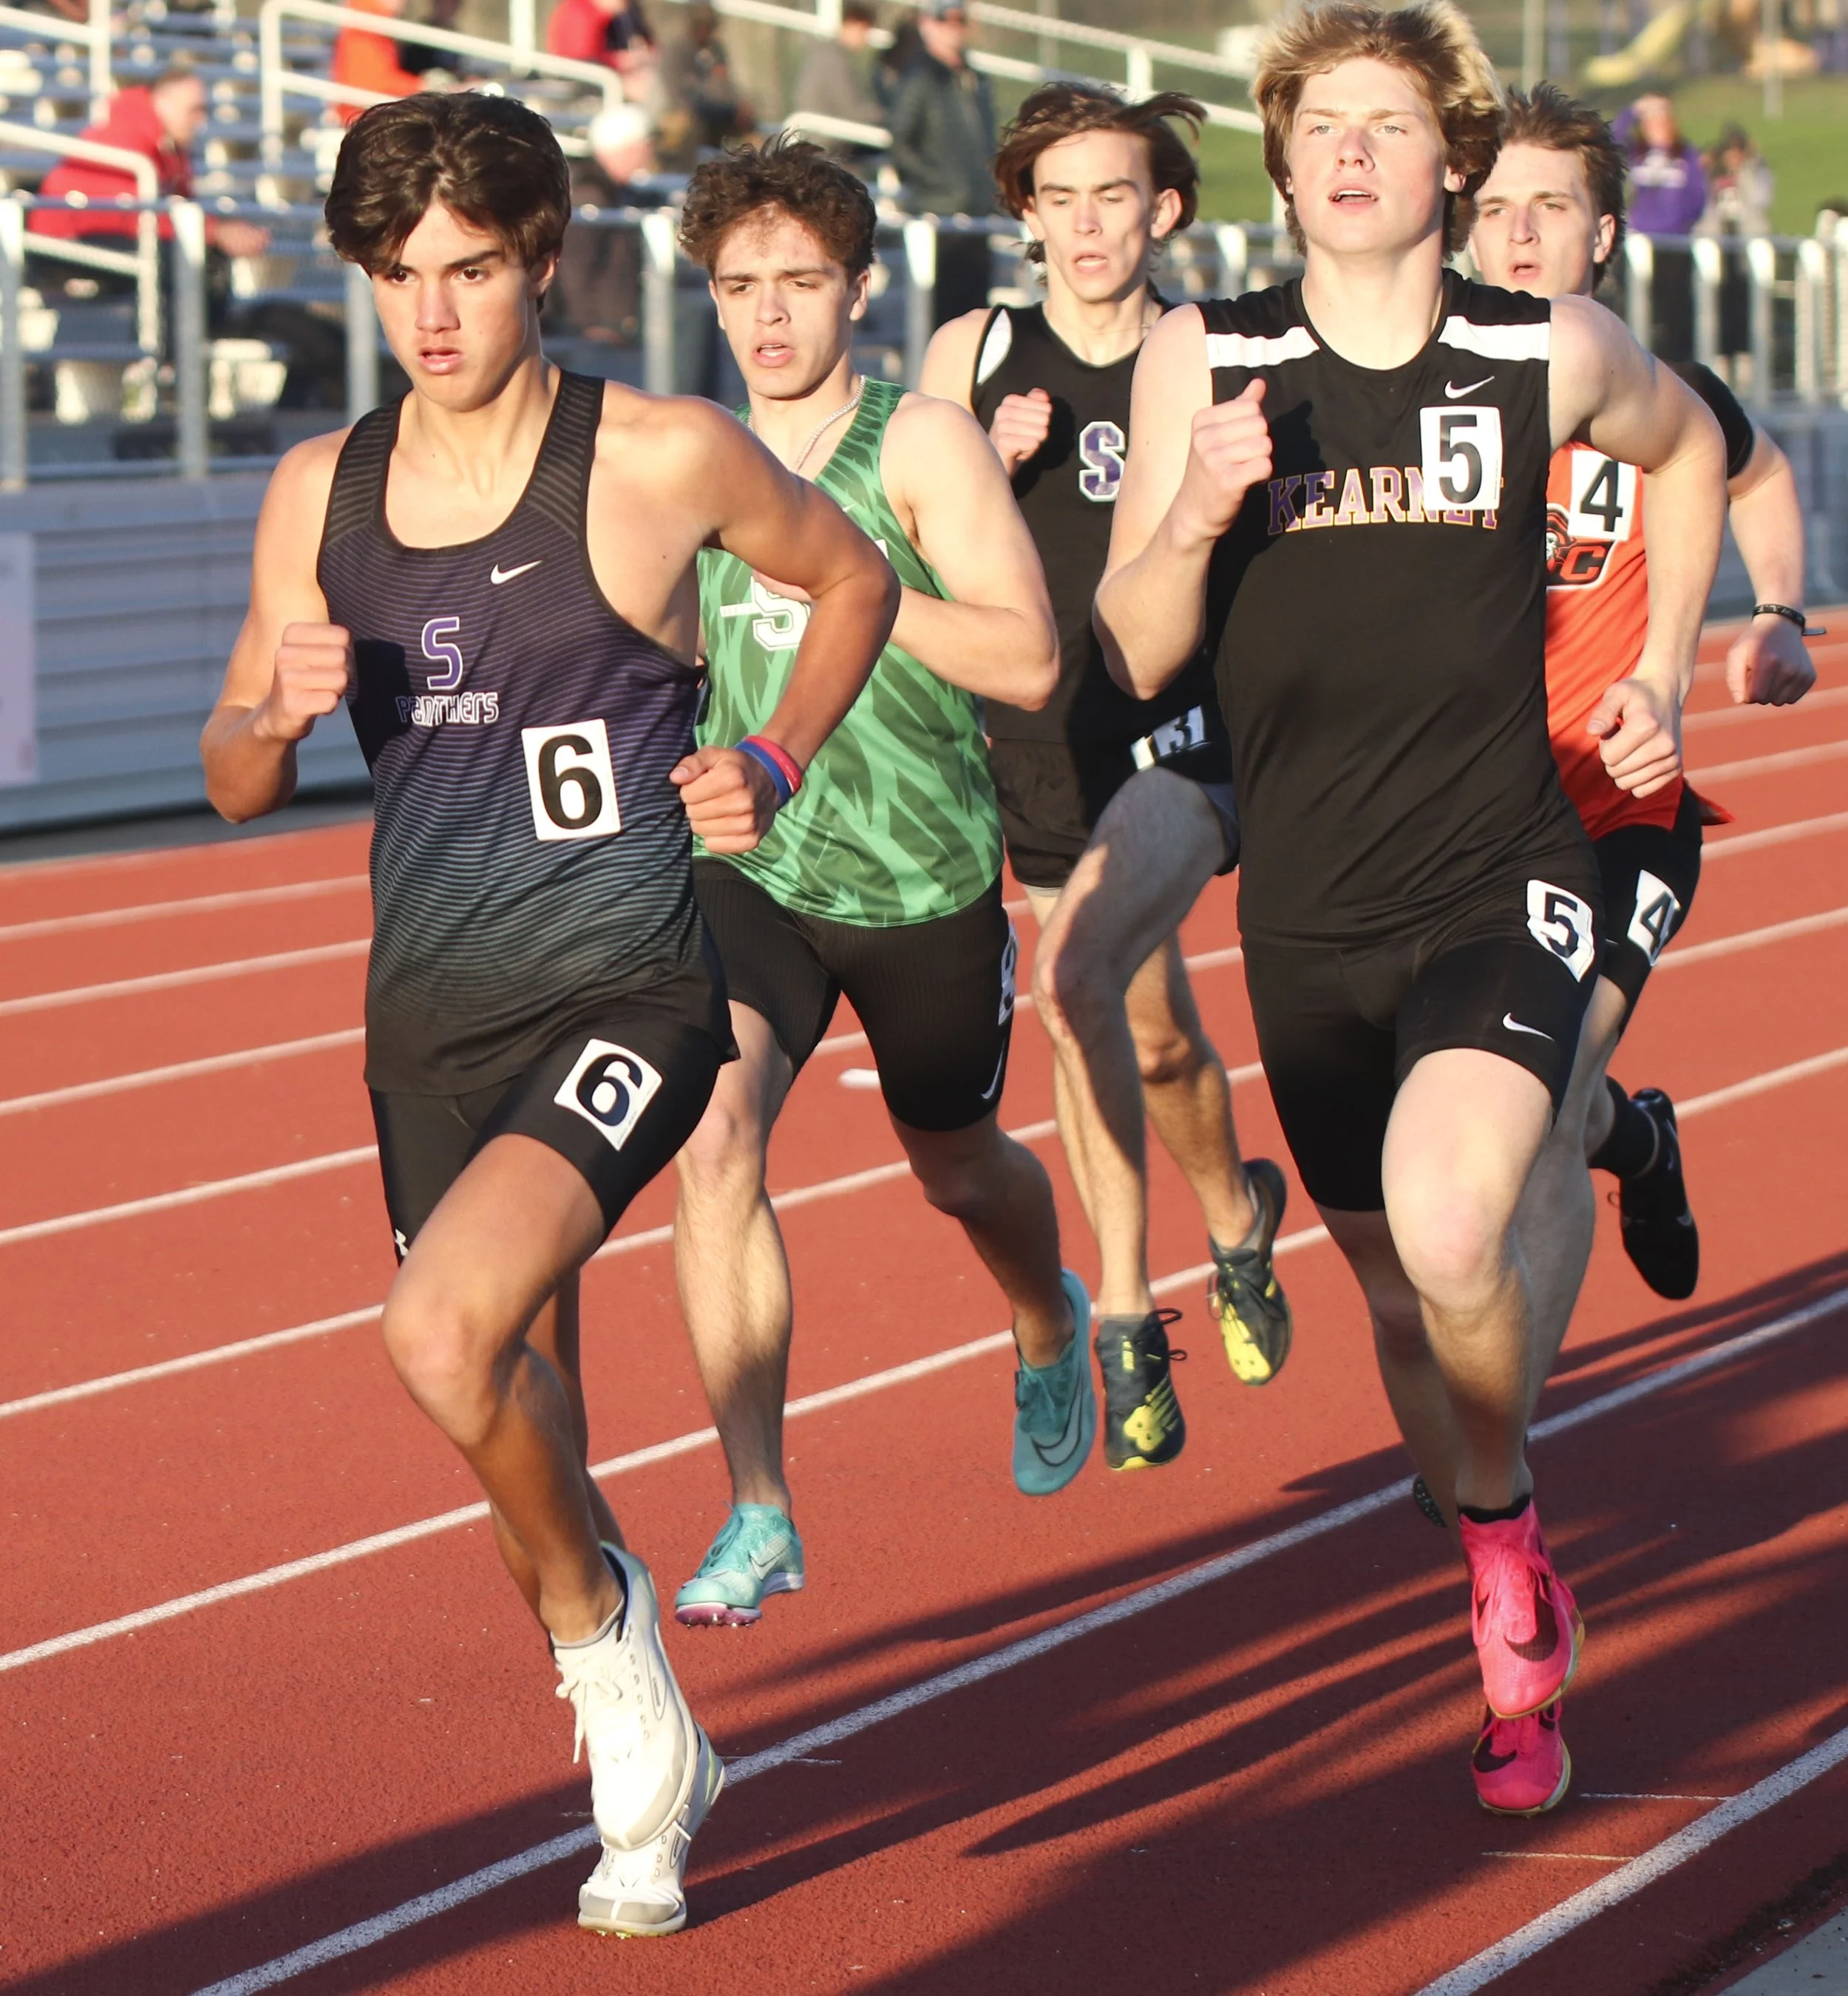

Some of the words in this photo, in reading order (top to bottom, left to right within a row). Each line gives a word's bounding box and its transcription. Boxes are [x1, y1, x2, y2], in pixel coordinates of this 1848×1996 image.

[1078, 421, 1125, 503] S
[1438, 414, 1483, 504] 5
[1580, 459, 1623, 532] 4
[1267, 466, 1504, 535] KEARN
[421, 616, 463, 690] S
[537, 733, 603, 830] 6
[1540, 891, 1580, 958] 5
[576, 1053, 643, 1127] 6
